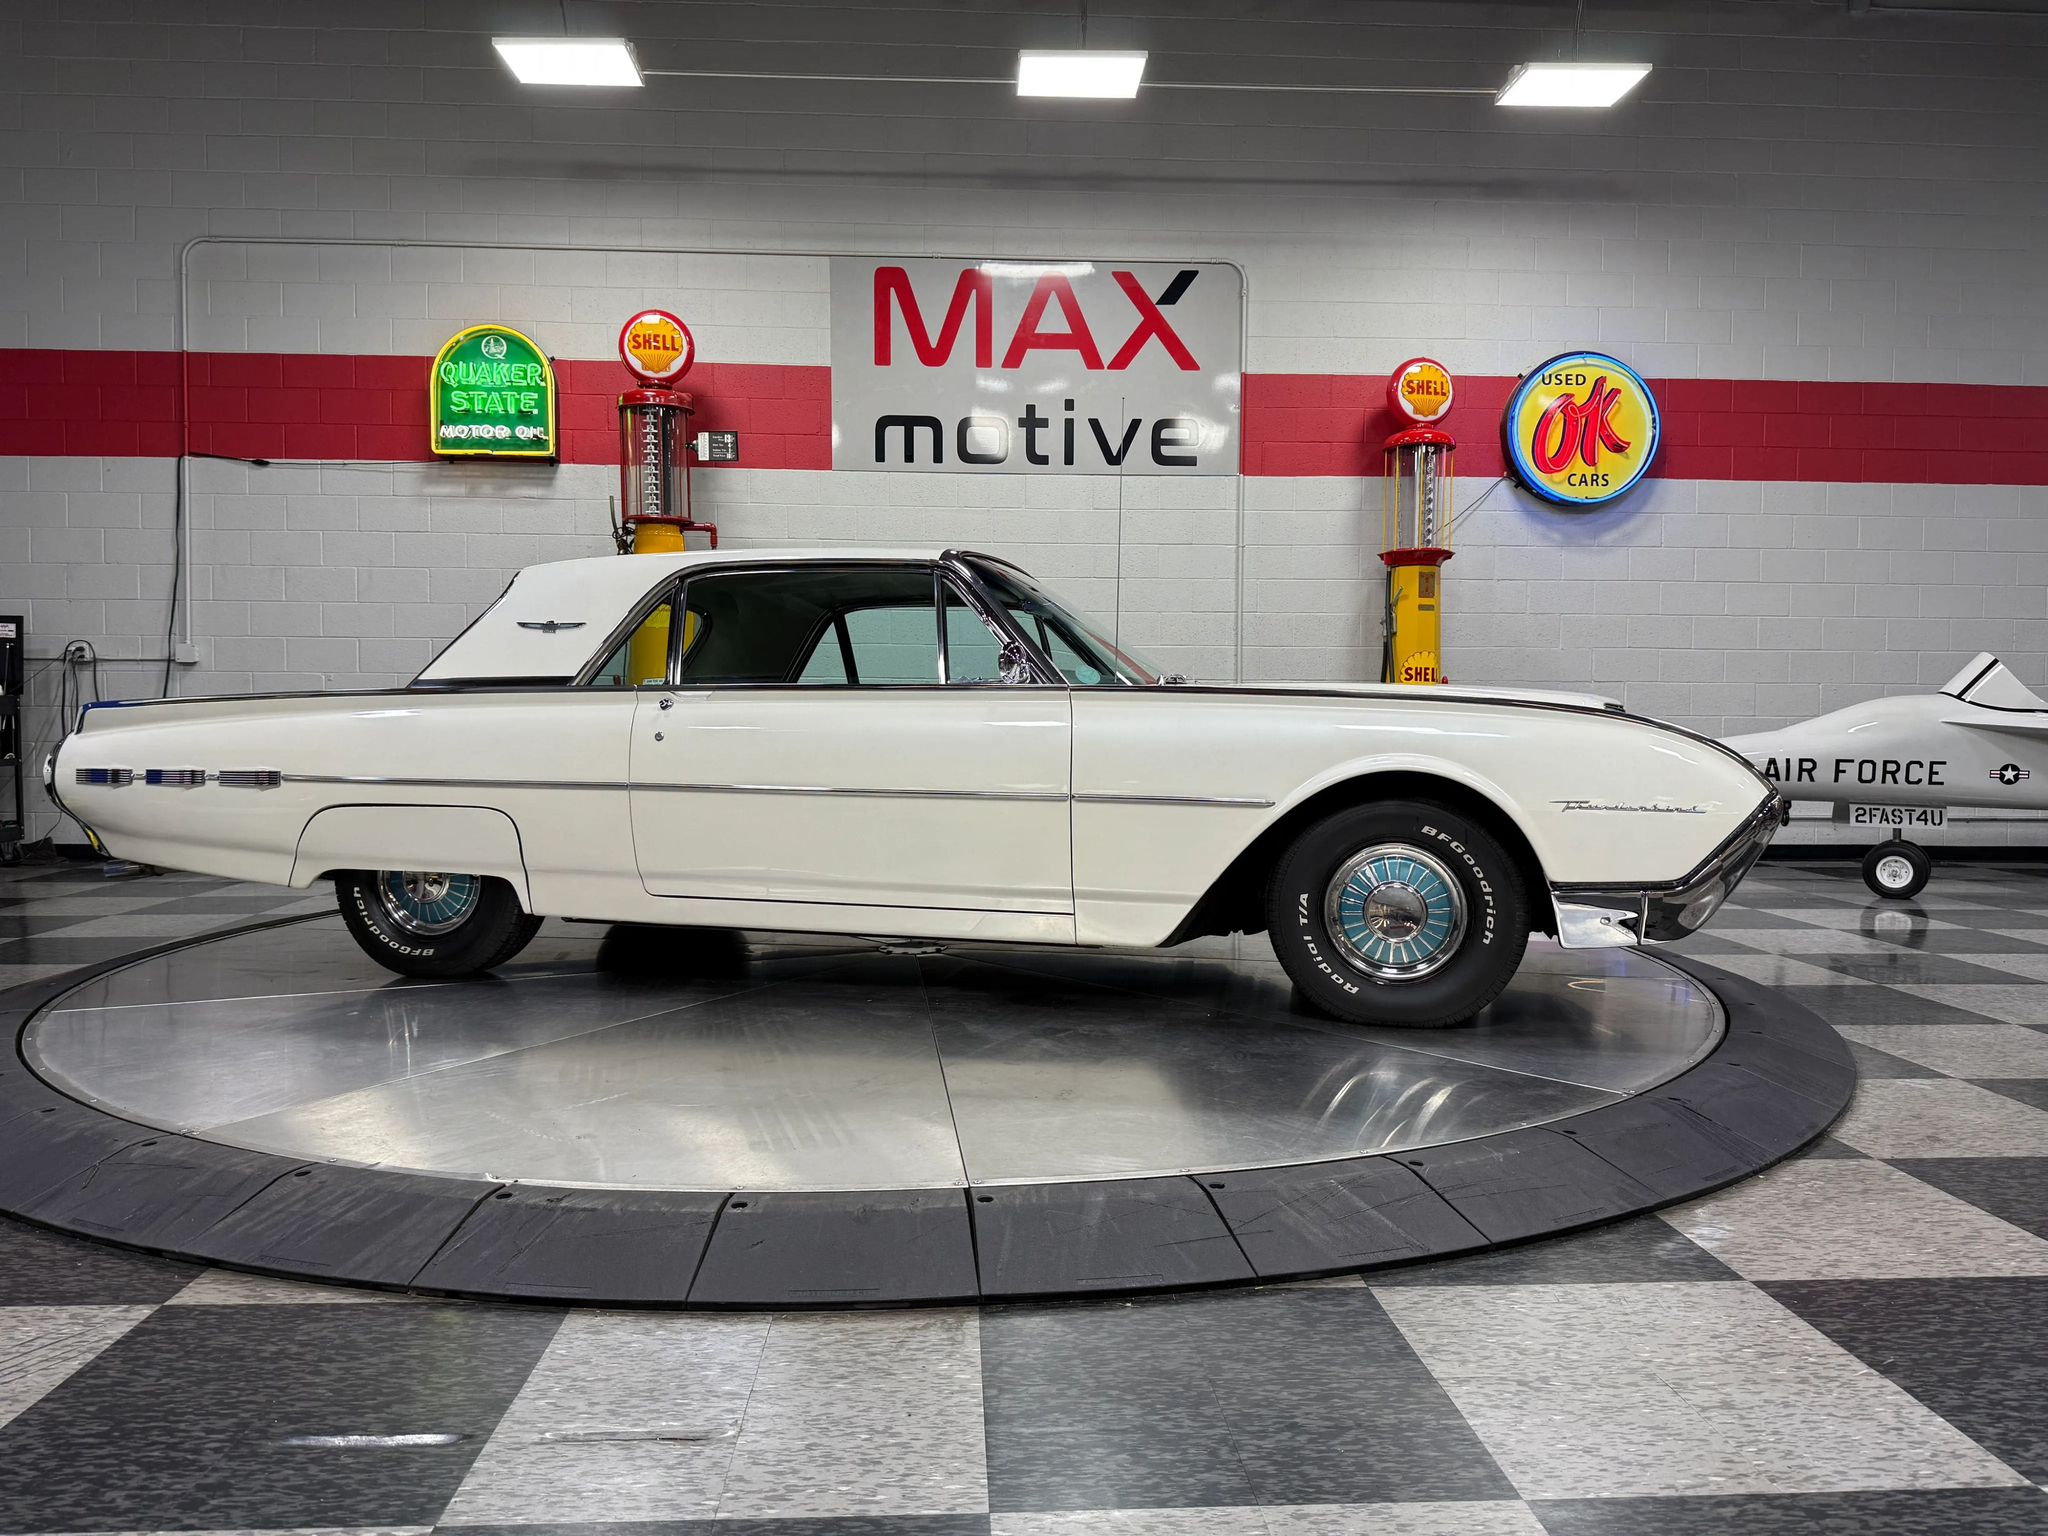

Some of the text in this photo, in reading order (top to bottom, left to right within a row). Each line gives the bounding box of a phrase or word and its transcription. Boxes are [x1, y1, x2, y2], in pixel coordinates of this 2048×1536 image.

[874, 266, 1200, 370] MAX
[631, 333, 679, 352] SHELL
[440, 361, 546, 387] QUAKER
[1541, 374, 1587, 386] USED
[1406, 380, 1447, 396] SHELL
[450, 391, 539, 414] STATE
[440, 425, 511, 438] MOTOR
[875, 398, 1199, 467] motive
[1531, 376, 1631, 474] OK
[1567, 473, 1609, 487] CARS
[1764, 757, 1947, 785] AIR FORCE
[1854, 806, 1943, 826] 2FAST4U
[1420, 825, 1497, 945] BFGoodrich
[353, 886, 435, 956] BFGoodrich
[1298, 893, 1360, 995] Radial T/A
